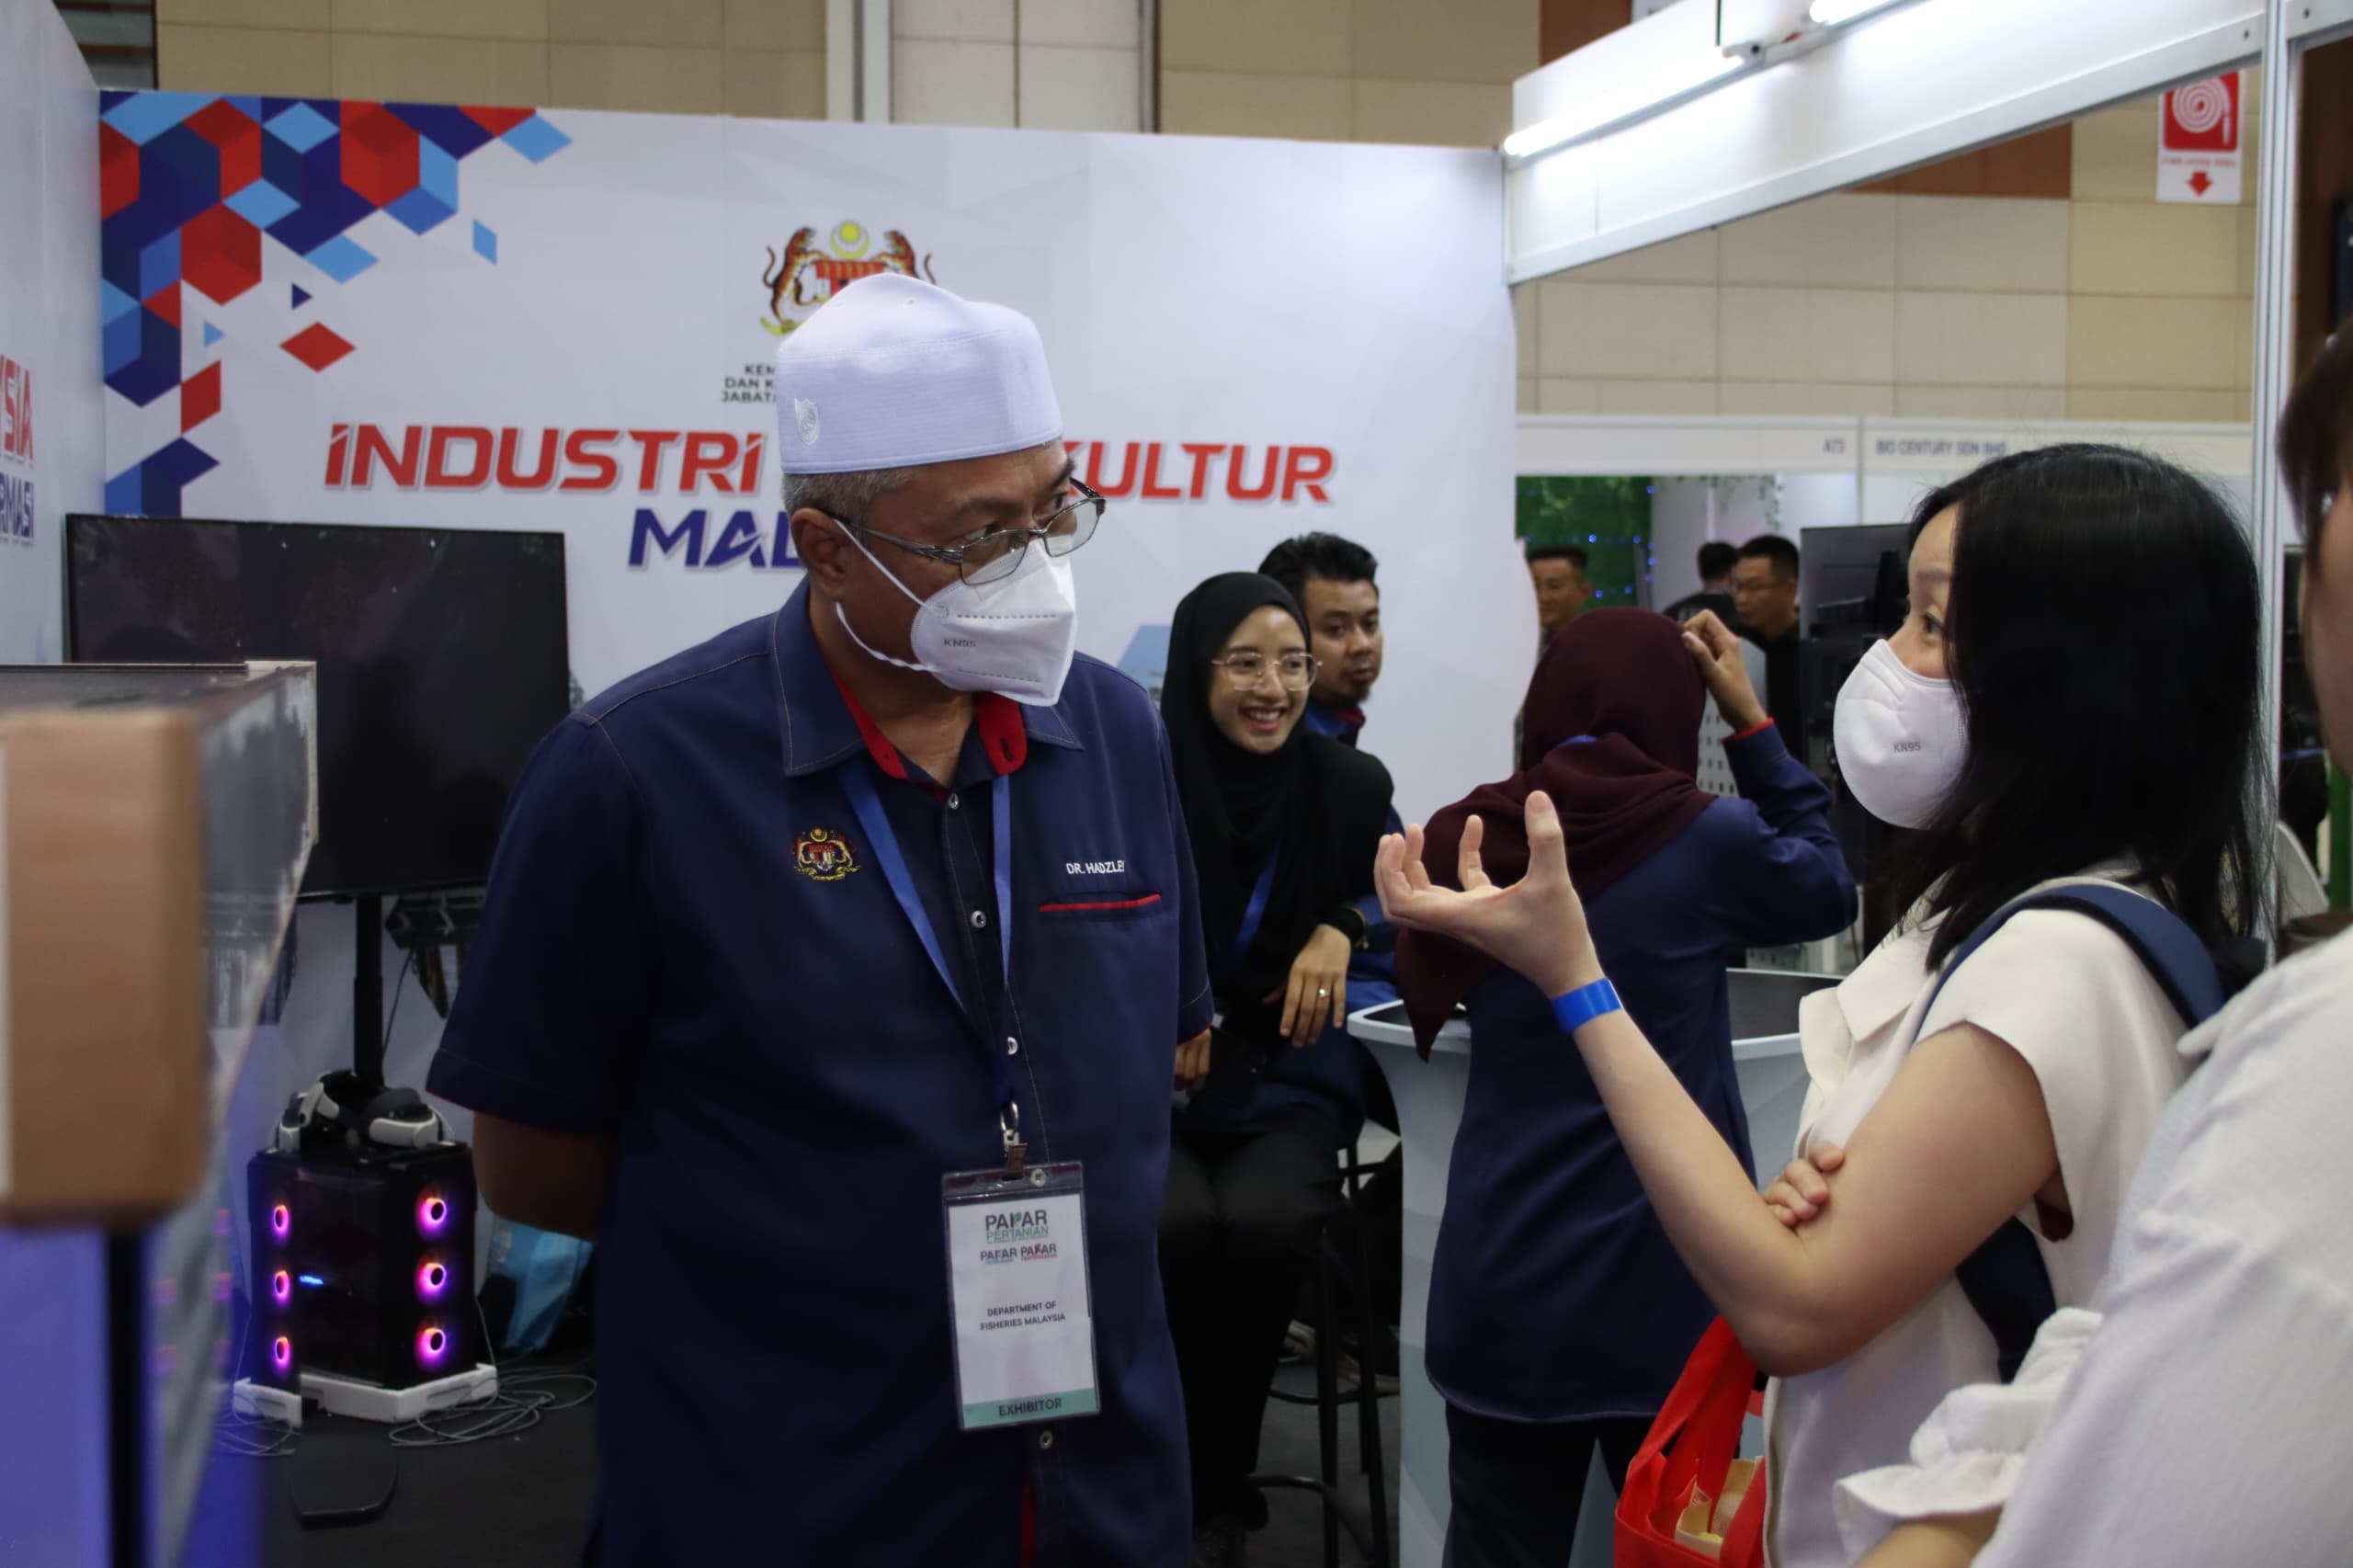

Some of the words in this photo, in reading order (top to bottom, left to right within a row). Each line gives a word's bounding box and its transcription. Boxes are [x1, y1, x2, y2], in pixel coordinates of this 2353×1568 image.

[724, 376, 759, 389] DAN
[1898, 438, 1952, 456] CENTURY
[324, 424, 764, 494] INDUSTRI
[943, 639, 976, 648] KN95
[1893, 742, 1921, 753] KN95
[1066, 862, 1086, 874] DR.
[986, 1225, 1050, 1242] PERTANIAN
[987, 1301, 1043, 1316] DEPARTMENT
[1045, 1301, 1056, 1310] OF
[980, 1318, 1023, 1331] FISHERIES
[1024, 1312, 1066, 1325] MALAYSIA
[998, 1397, 1063, 1416] EXHIBITOR
